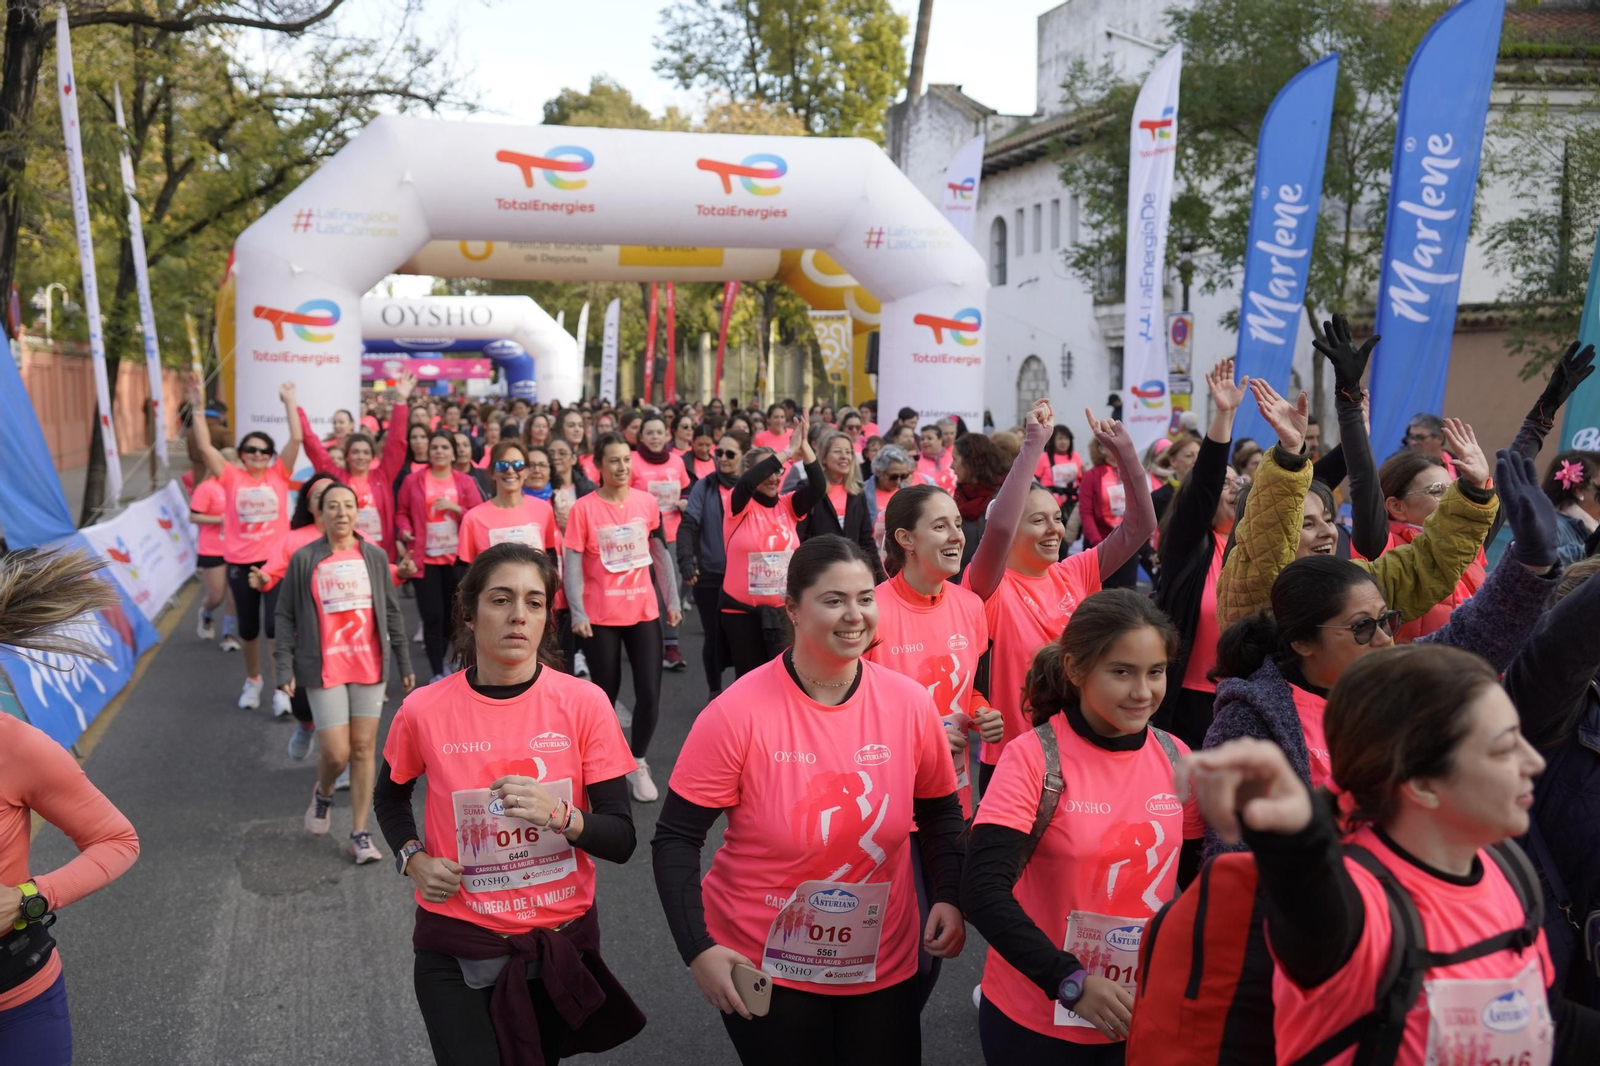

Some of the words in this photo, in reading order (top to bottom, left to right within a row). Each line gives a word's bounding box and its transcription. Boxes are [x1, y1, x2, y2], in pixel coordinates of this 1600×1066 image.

[495, 198, 595, 214] TotalEnergies
[696, 204, 788, 220] TotalEnergies
[1388, 133, 1461, 323] Marlene
[1246, 183, 1309, 345] Marlene
[381, 303, 493, 328] OYSHO
[252, 350, 341, 366] TotalEnergies
[616, 543, 636, 552] 016
[764, 569, 782, 578] 016
[891, 642, 924, 656] OYSHO
[442, 741, 492, 755] OYSHO
[774, 750, 817, 765] OYSHO
[1064, 800, 1112, 815] OYSHO
[496, 827, 540, 847] 016
[508, 850, 529, 861] 6440
[475, 865, 501, 874] CARRERA
[517, 860, 535, 868] MUJER
[538, 855, 560, 864] SEVILLA
[472, 875, 510, 887] OYSHO
[531, 866, 565, 879] Santander
[513, 897, 528, 911] DE
[530, 895, 544, 908] LA
[544, 886, 576, 904] MUJER
[813, 896, 856, 908] ASTURIANA
[516, 909, 537, 920] 2025
[808, 924, 852, 943] 016
[1076, 931, 1102, 941] SUMA
[781, 952, 806, 963] CARRERA
[845, 958, 863, 966] SEVILLA
[816, 948, 837, 957] 5561
[775, 962, 812, 977] OYSHO
[834, 969, 864, 979] Santander
